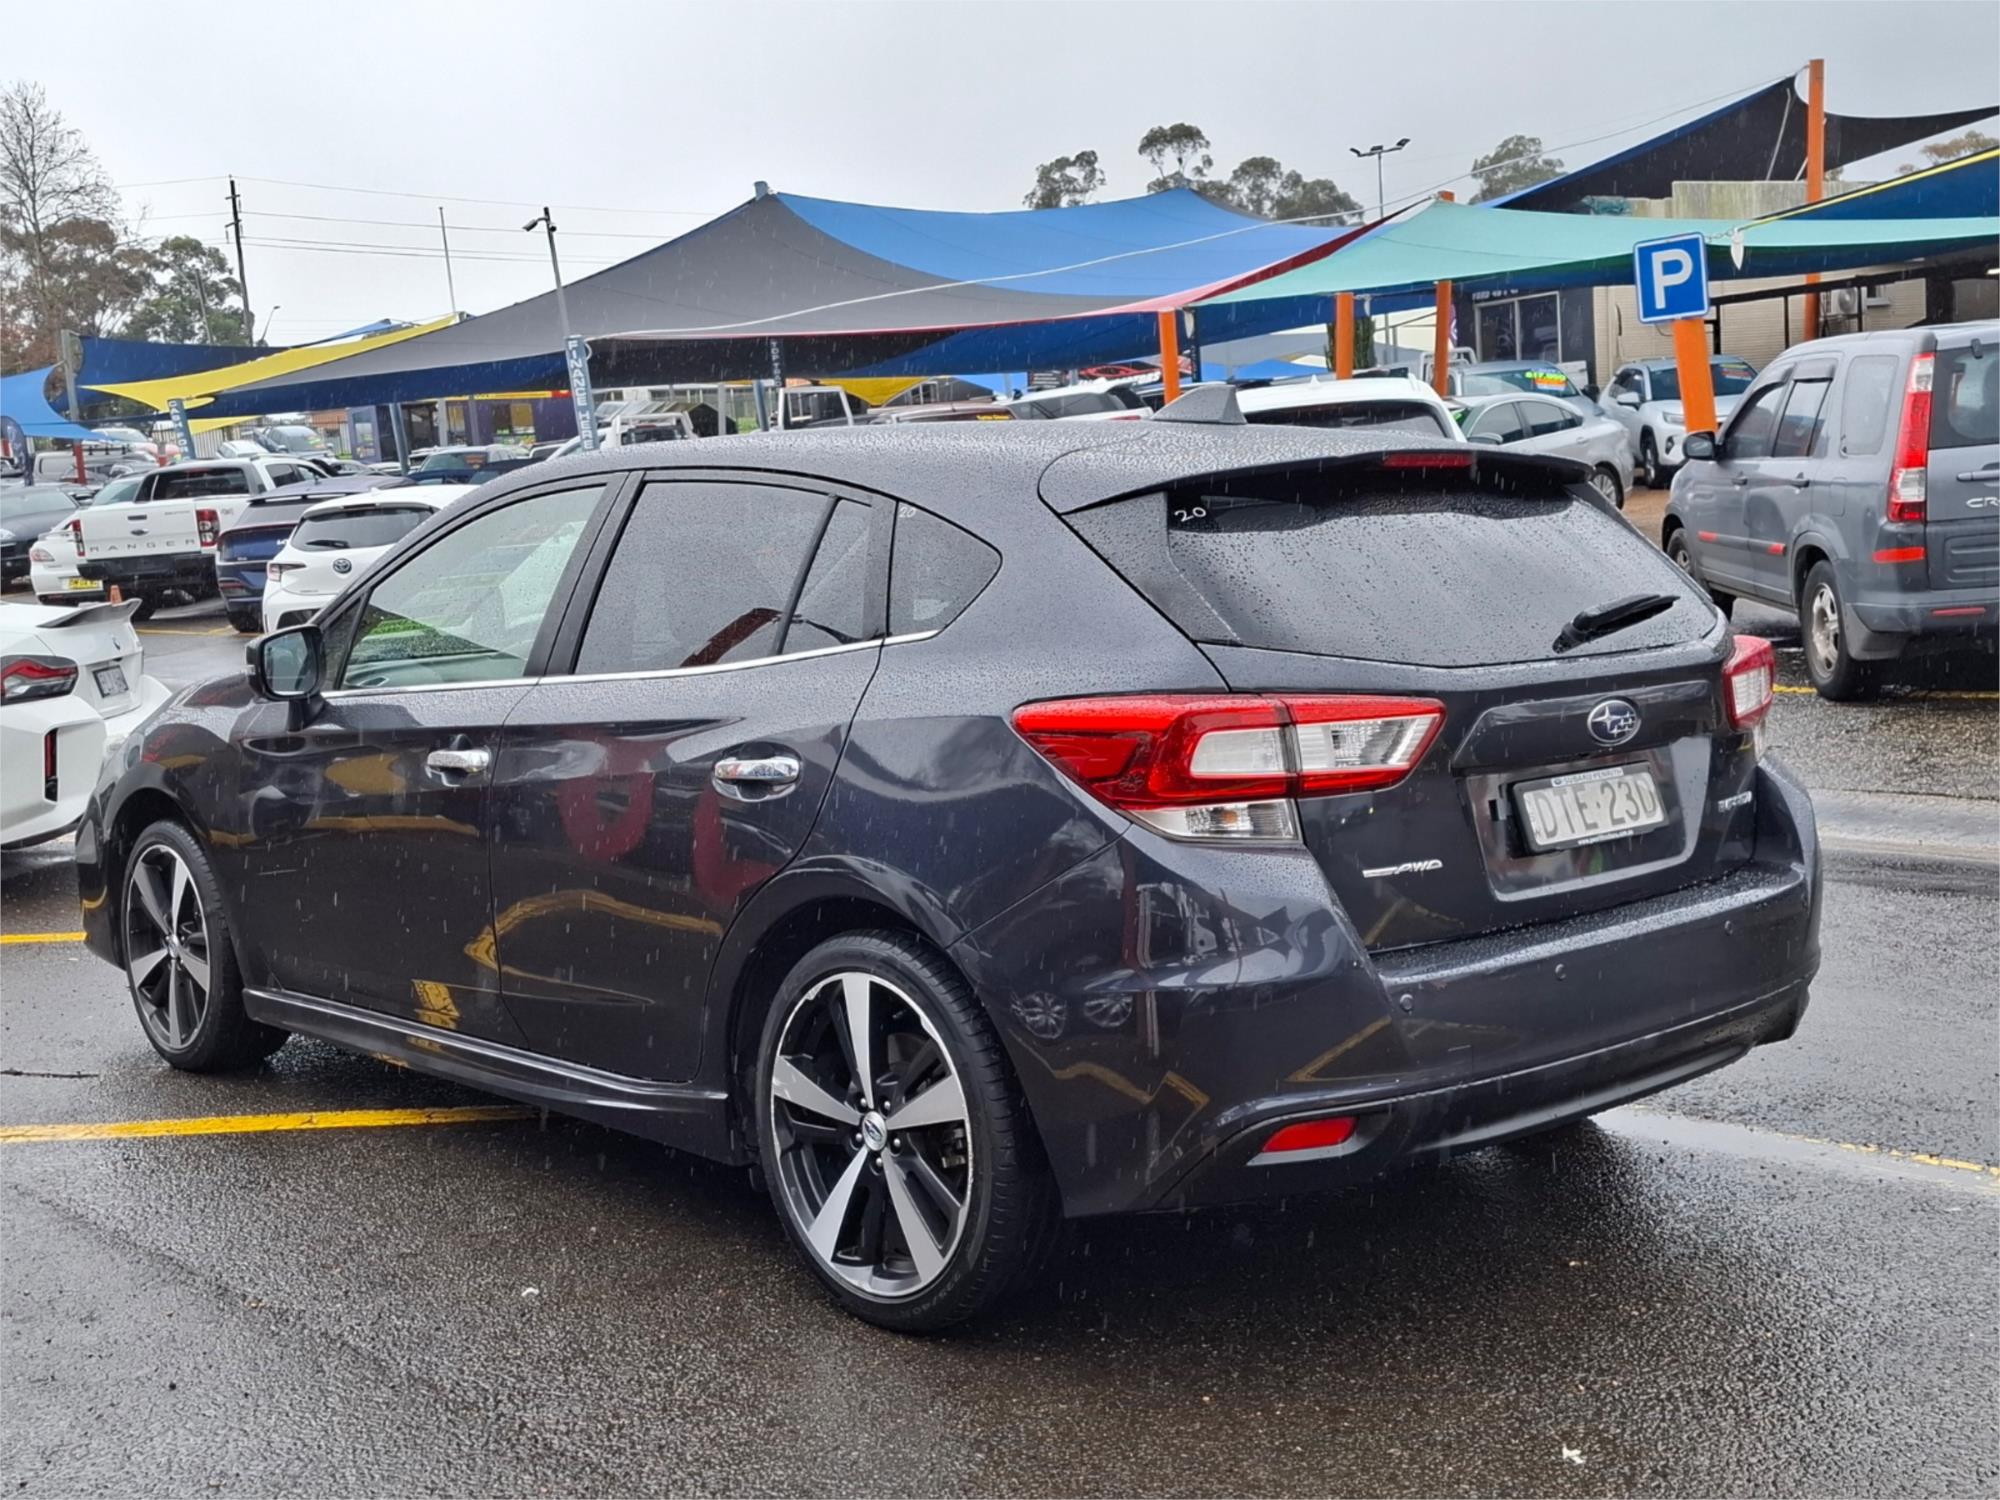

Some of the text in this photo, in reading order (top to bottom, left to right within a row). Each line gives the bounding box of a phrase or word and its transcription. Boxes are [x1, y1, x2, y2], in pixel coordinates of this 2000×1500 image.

[1651, 248, 1693, 309] P
[567, 340, 594, 449] FINANCE HERE
[899, 506, 916, 518] 20
[1174, 506, 1207, 522] 20
[89, 538, 195, 552] RANGER
